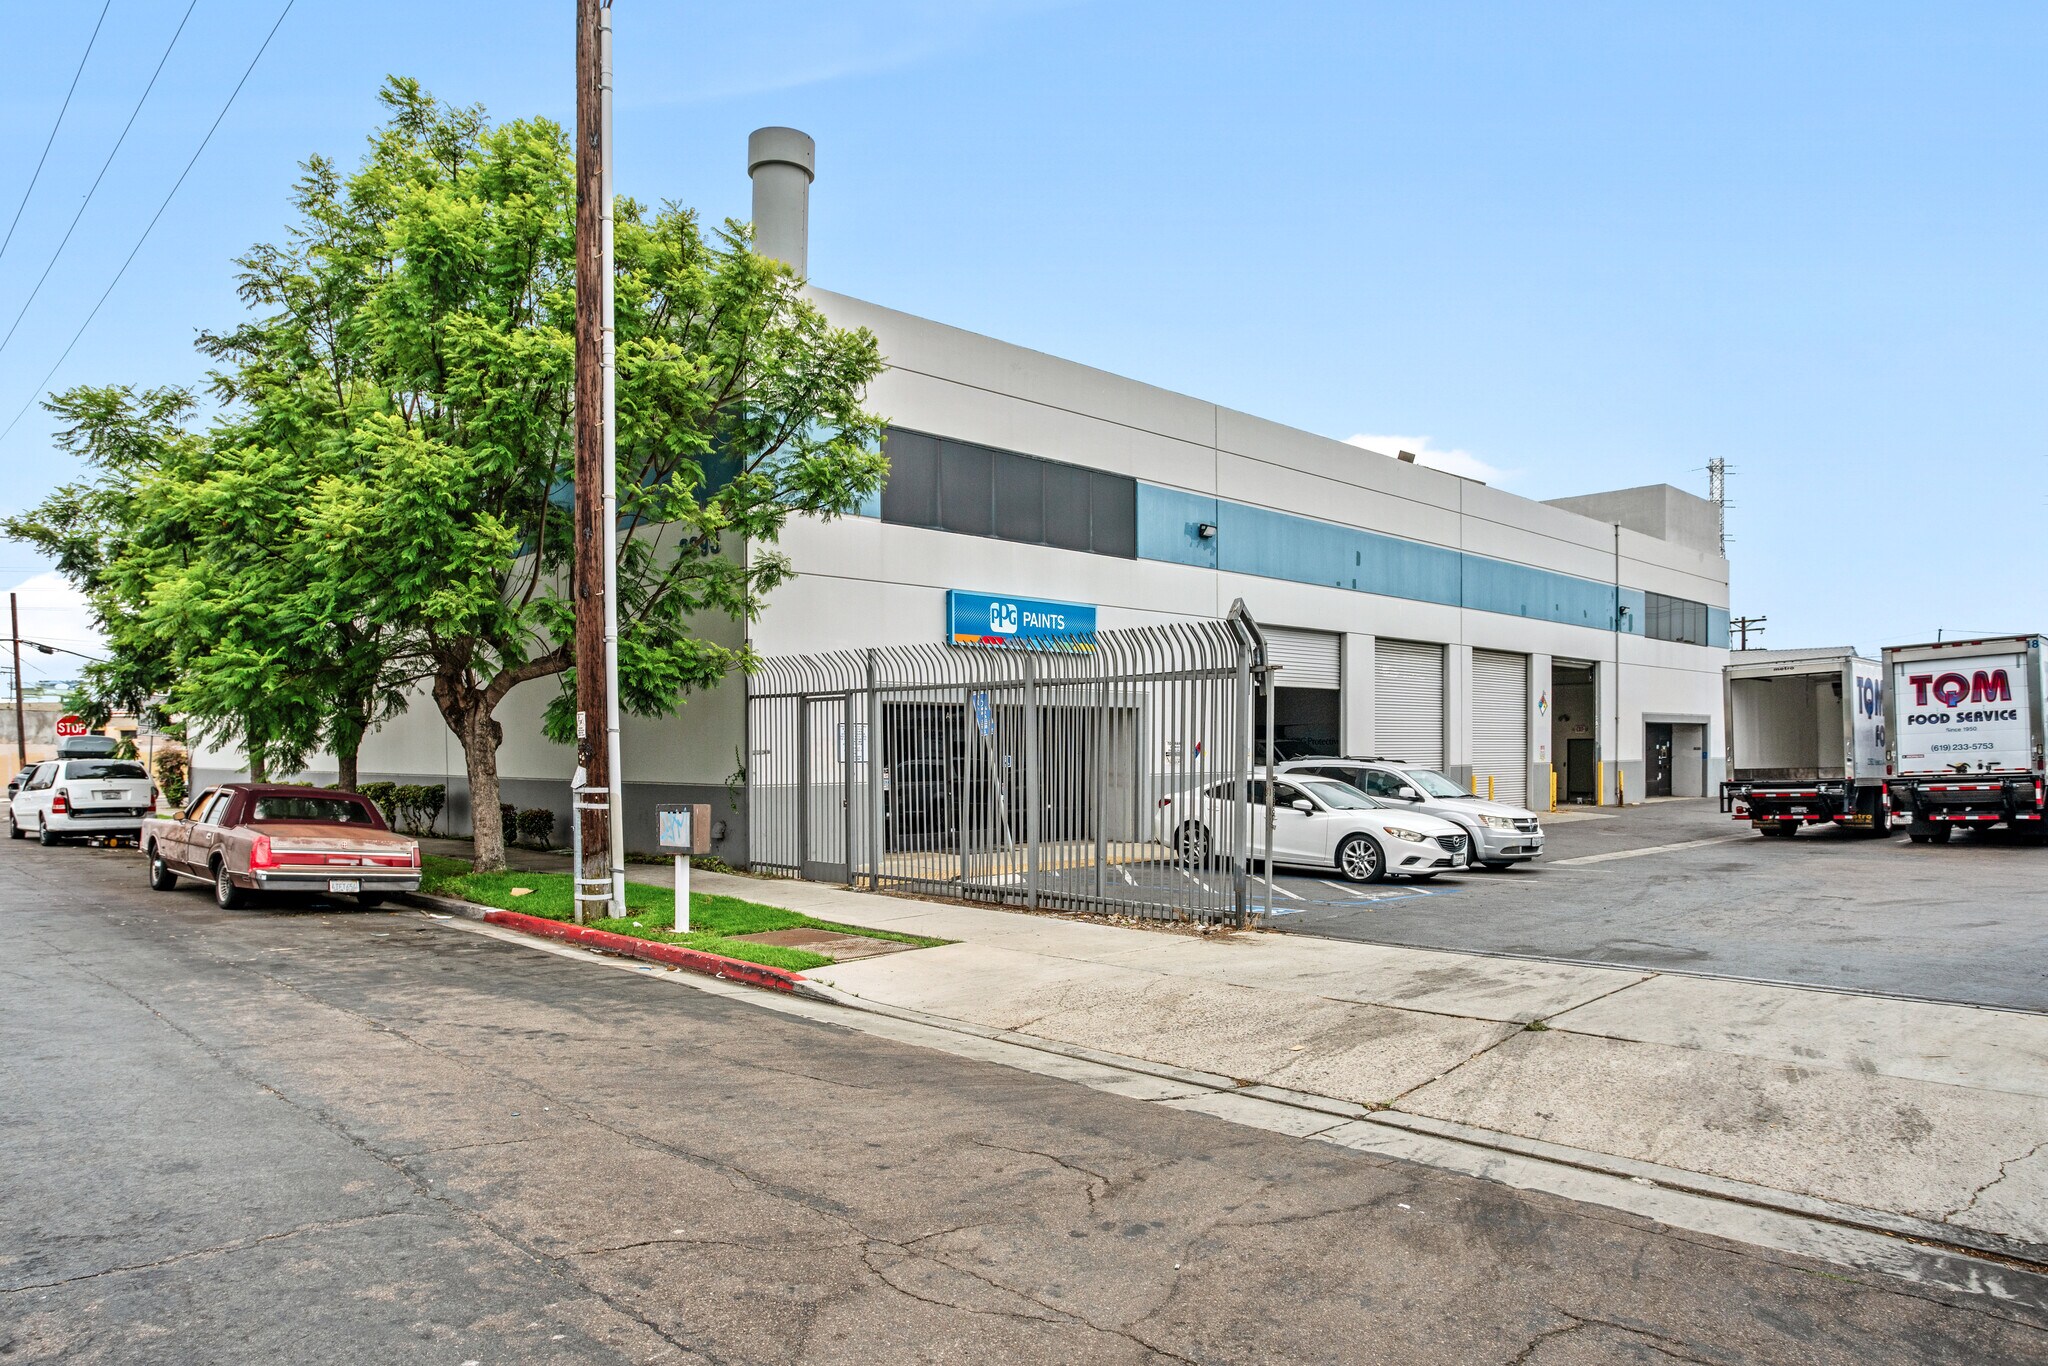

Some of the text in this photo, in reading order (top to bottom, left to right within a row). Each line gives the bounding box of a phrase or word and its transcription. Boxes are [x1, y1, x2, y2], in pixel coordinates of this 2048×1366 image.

[990, 600, 1065, 631] PPG PAINTS
[1907, 709, 2017, 725] FOOD SERVICE
[58, 722, 86, 733] STOP
[1931, 742, 1994, 752] (619) 233-5753
